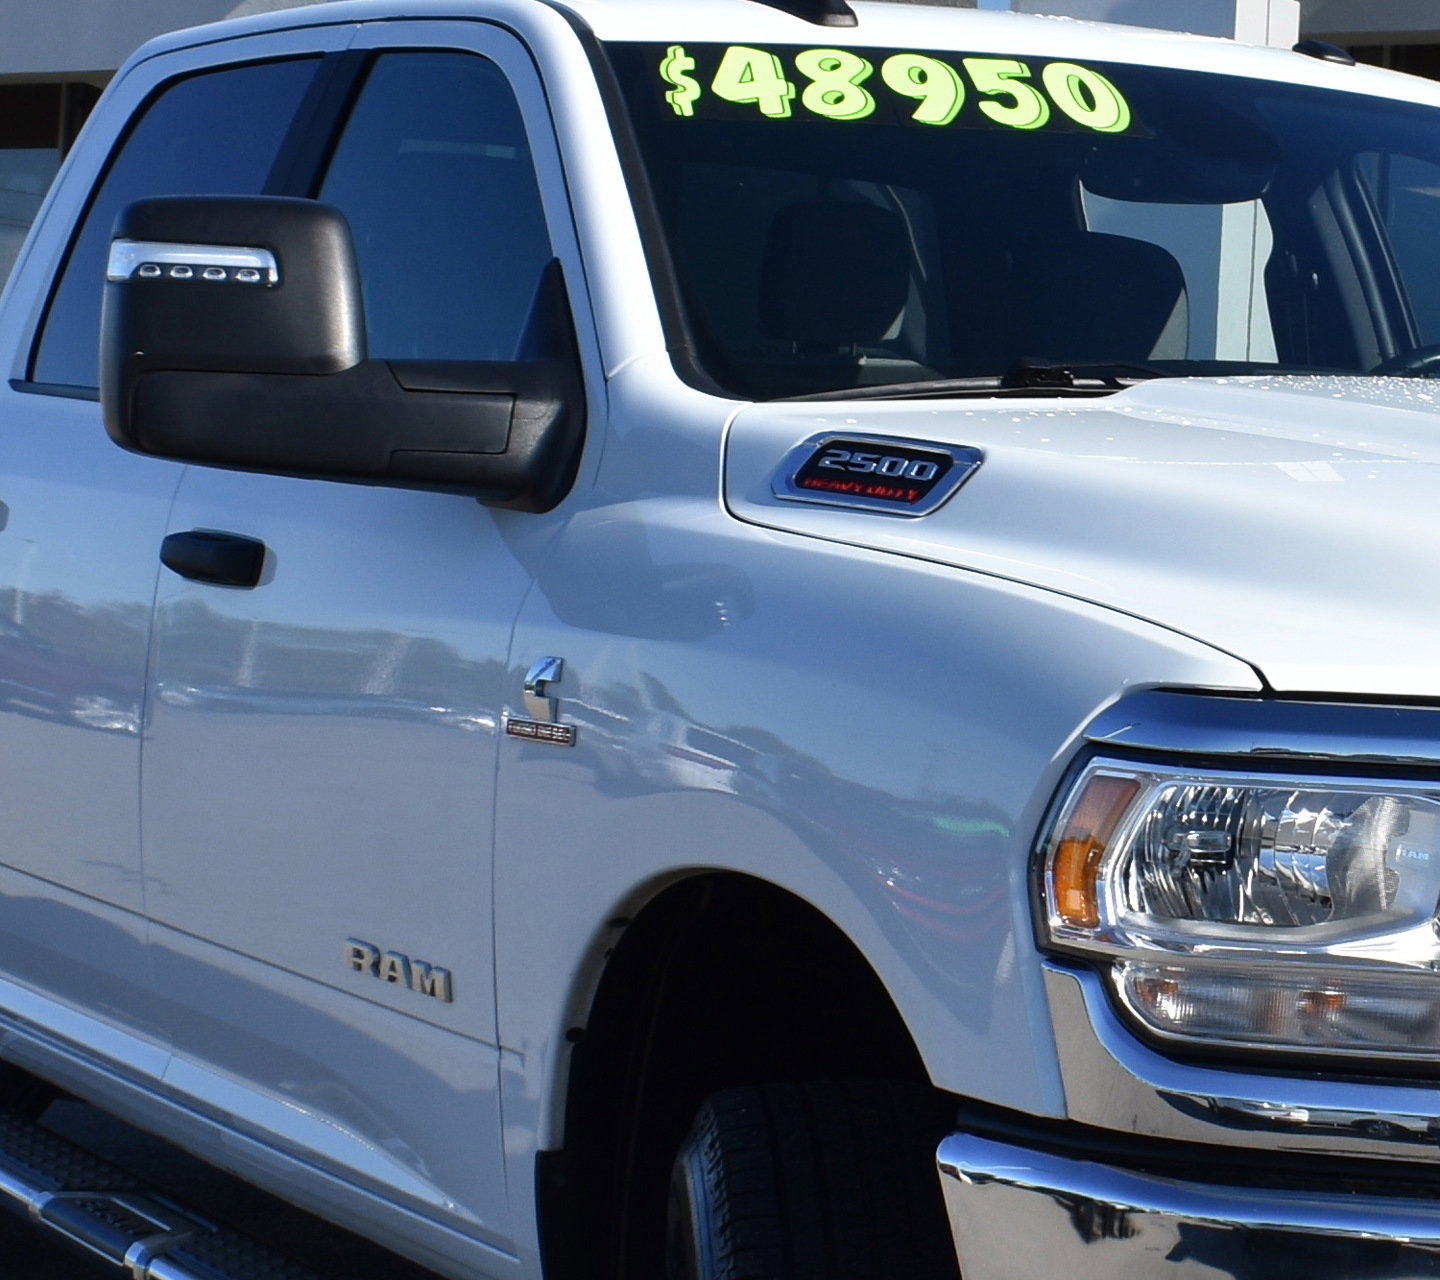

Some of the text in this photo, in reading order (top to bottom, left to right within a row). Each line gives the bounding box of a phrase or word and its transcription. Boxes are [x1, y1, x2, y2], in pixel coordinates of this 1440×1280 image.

[660, 45, 1132, 134] $48950
[803, 476, 863, 494] HEAVY
[818, 449, 939, 481] 2500
[344, 937, 454, 1003] RAM
